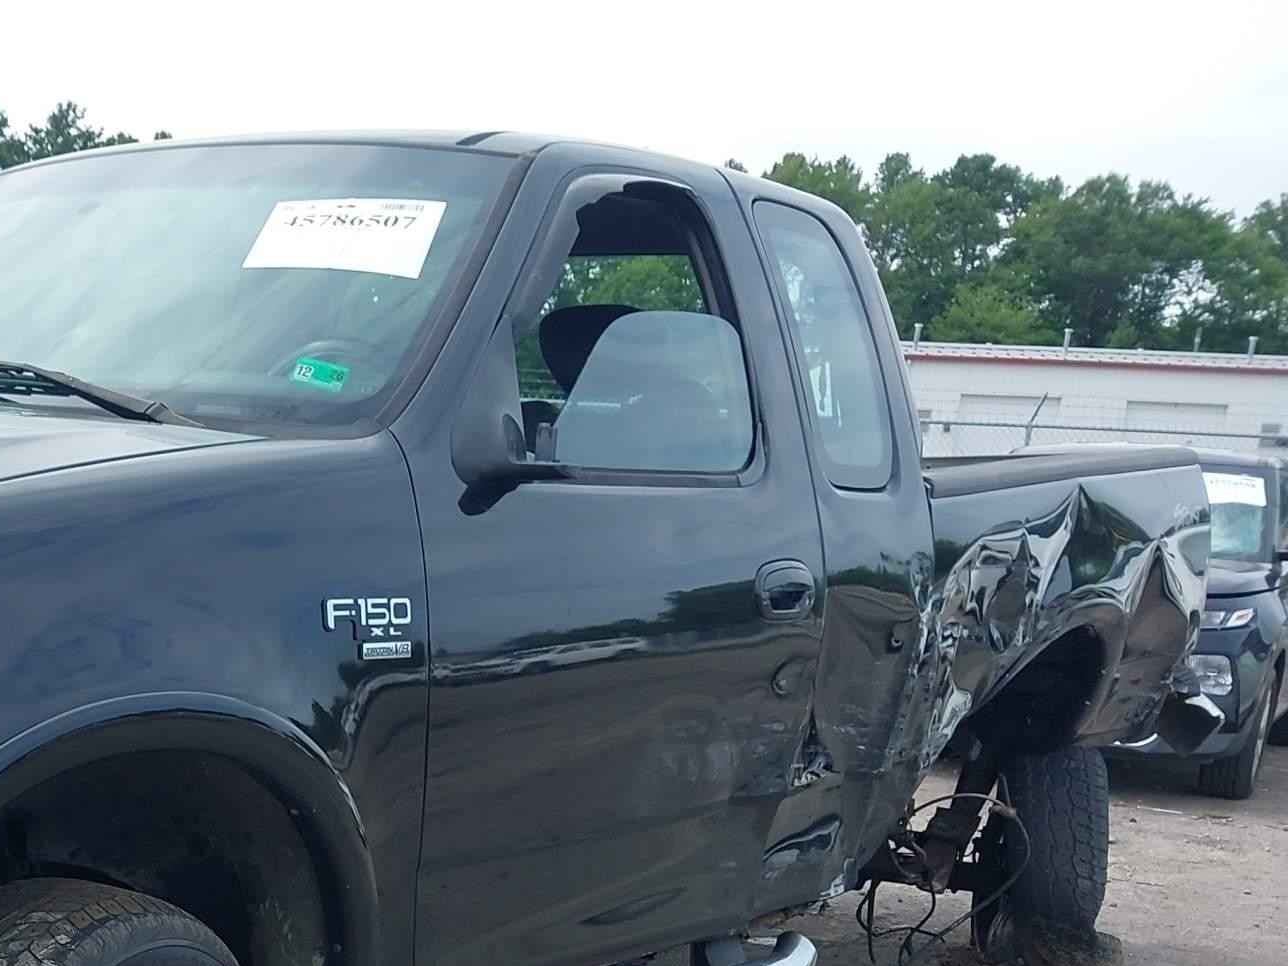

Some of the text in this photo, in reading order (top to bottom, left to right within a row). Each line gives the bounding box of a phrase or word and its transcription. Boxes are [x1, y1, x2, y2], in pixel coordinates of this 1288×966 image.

[284, 214, 417, 229] 45786507
[297, 366, 313, 379] 12
[370, 627, 402, 636] XL
